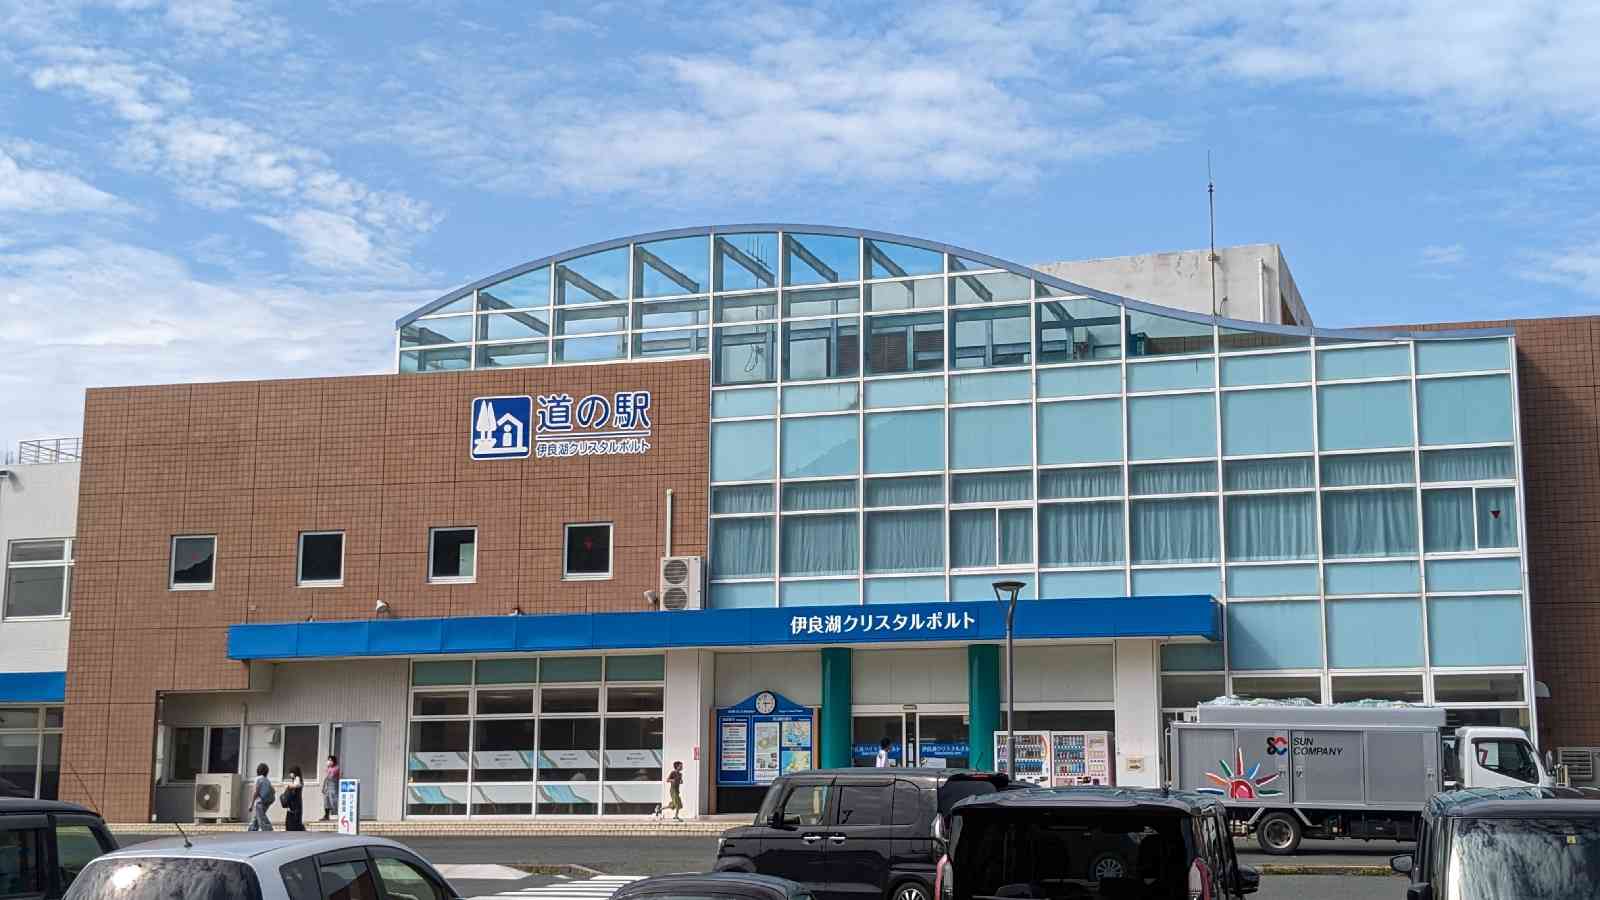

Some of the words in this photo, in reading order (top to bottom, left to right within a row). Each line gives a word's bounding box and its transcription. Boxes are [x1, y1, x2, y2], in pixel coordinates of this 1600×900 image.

[537, 391, 650, 431] 道の駅
[791, 612, 975, 634] 伊良湖クリスタルポルト
[1293, 737, 1313, 746] SUN
[1293, 747, 1343, 756] COMPANY
